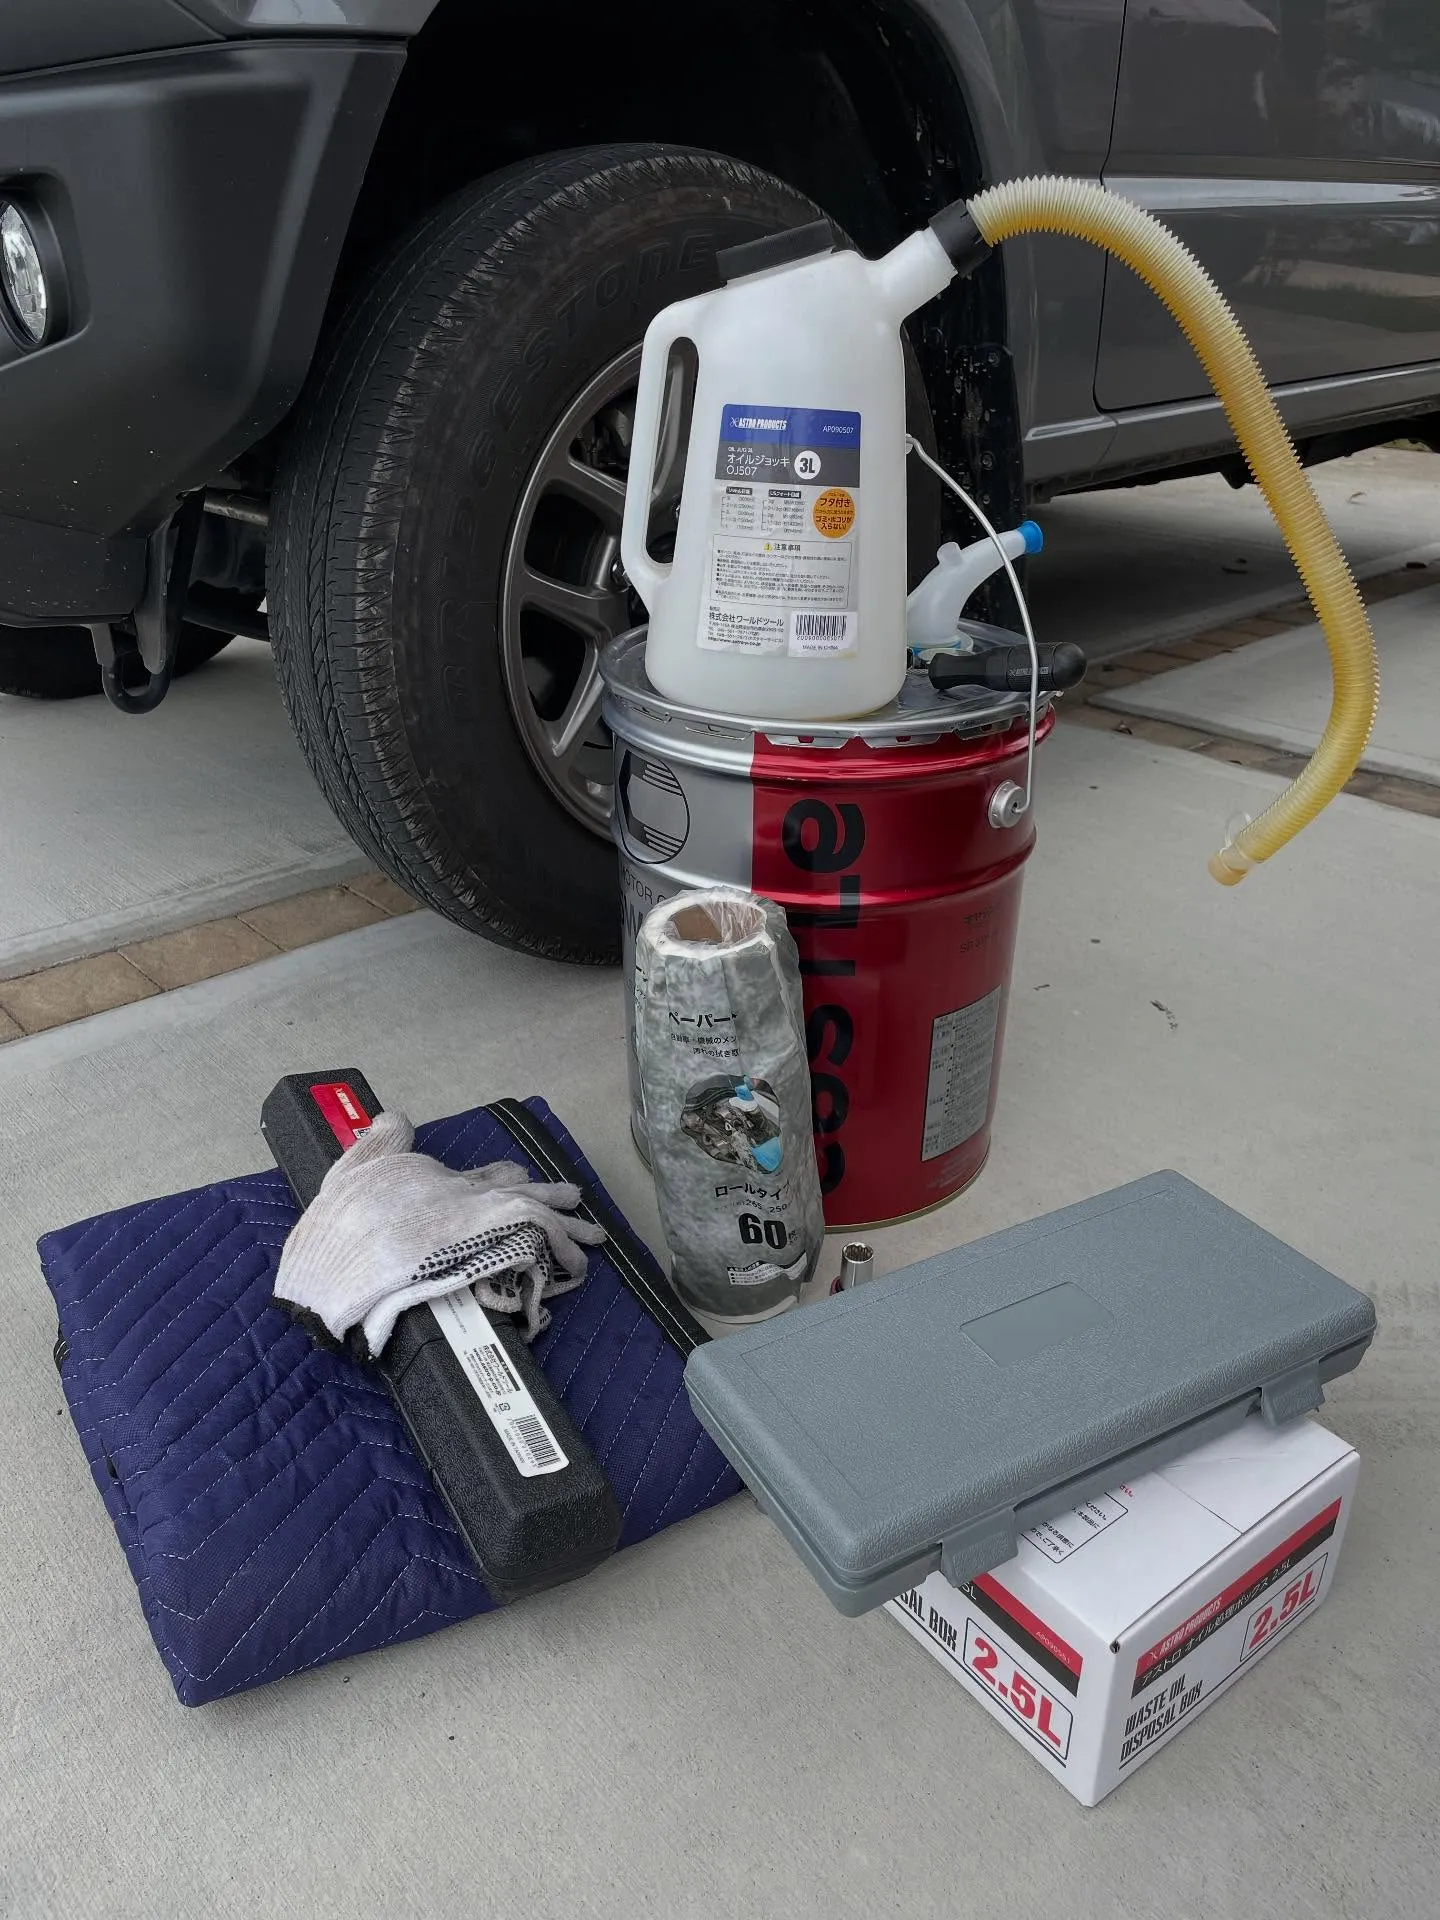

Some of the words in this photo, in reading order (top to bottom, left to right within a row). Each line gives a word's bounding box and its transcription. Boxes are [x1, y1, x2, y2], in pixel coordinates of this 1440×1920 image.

[738, 417, 757, 429] ASTRO
[756, 418, 788, 430] PRODUCTS
[822, 425, 854, 434] AP090507
[726, 465, 758, 476] OJ507
[727, 453, 790, 467] オイルジョッキ
[799, 457, 816, 474] 3L
[820, 498, 851, 507] フタ付き
[774, 543, 801, 551] 注意事項
[708, 612, 784, 627] 株式会社ワールドツール
[738, 1212, 788, 1249] 60
[1140, 1647, 1183, 1687] アストロ
[1184, 1576, 1270, 1653] オイル処理ボックス
[1271, 1557, 1292, 1581] 2.5L
[1247, 1570, 1316, 1649] 2.5L
[928, 1606, 958, 1652] BOX
[1159, 1621, 1186, 1657] ASTRO
[1184, 1596, 1223, 1636] PRODUCTS
[970, 1636, 1062, 1748] 2.5L
[1124, 1686, 1167, 1737] WASTE
[1168, 1672, 1187, 1702] OIL
[1119, 1703, 1177, 1763] DISPOSAL
[1179, 1679, 1203, 1716] BOX
